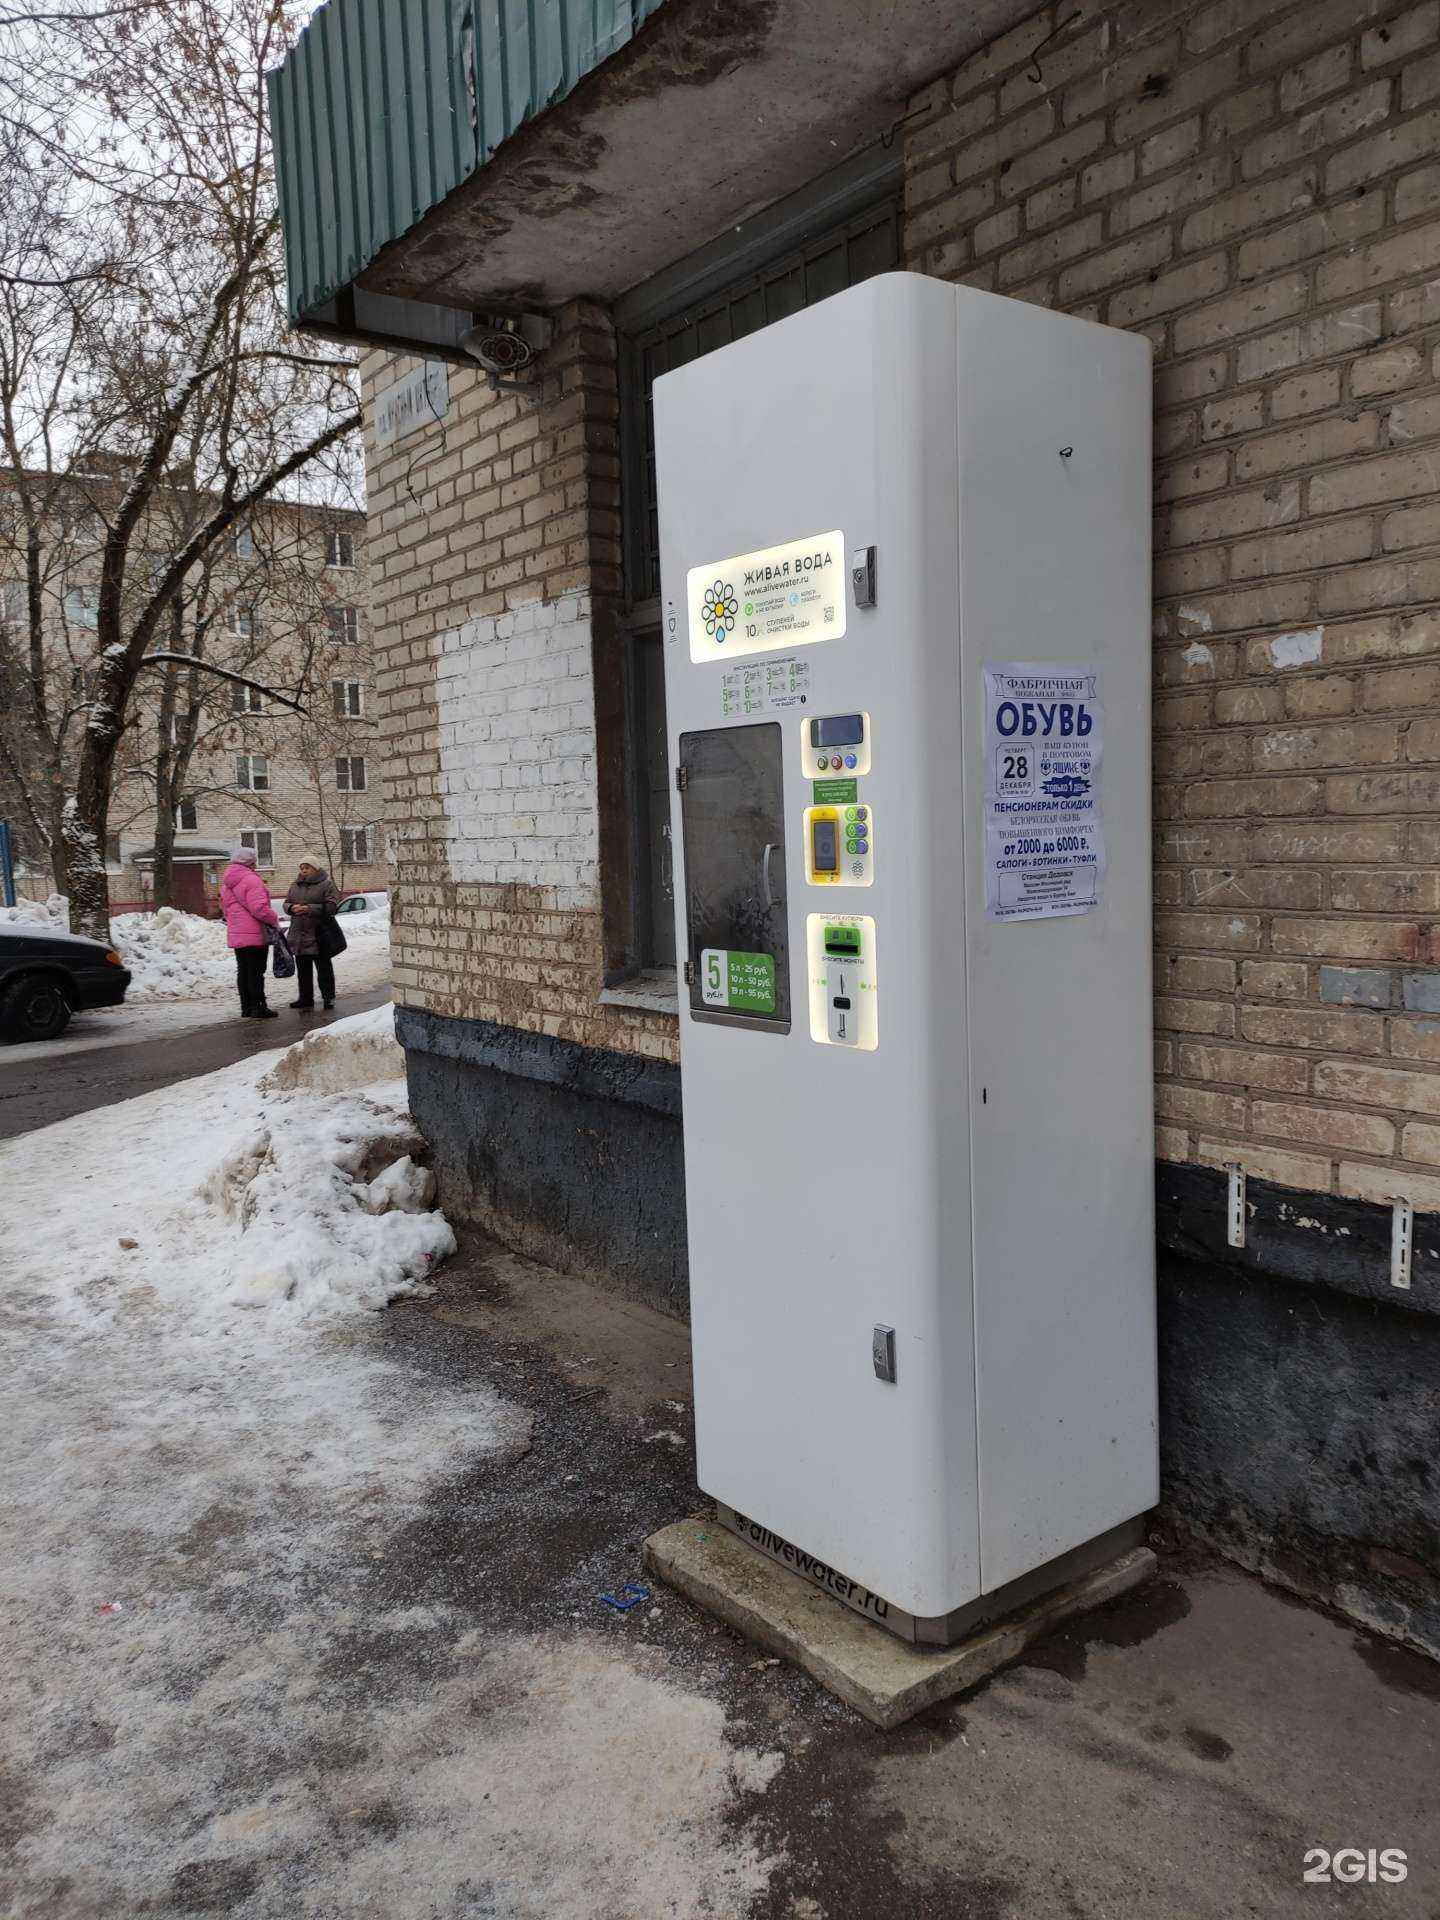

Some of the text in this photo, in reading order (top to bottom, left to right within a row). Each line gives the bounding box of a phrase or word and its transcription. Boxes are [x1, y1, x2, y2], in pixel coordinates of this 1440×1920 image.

[744, 552, 832, 586] ЖИВАЯ ВОДА
[744, 576, 809, 597] www.alivewater.ru
[767, 615, 795, 627] СТУПЕНЕЙ
[767, 620, 810, 634] ОЧИСТКИ ВОДЫ
[1007, 679, 1083, 690] ФАБРИЧНАЯ
[996, 701, 1092, 737] ОБУВЬ
[1003, 756, 1028, 779] 28
[1052, 761, 1080, 774] ЯЩИКЕ
[1000, 782, 1031, 790] ДЕКАБРЯ
[994, 800, 1093, 813] ПЕНСИОНЕРАМ СКИДКИ
[1004, 845, 1016, 856] от
[1017, 838, 1040, 855] 2000
[1043, 842, 1055, 855] до
[1056, 836, 1079, 852] 6000
[996, 854, 1097, 869] САПОГИ БОТИНКИ ТУФЛИ
[708, 955, 720, 990] 5
[731, 975, 738, 983] 10
[749, 1523, 889, 1619] alivewater.ru
